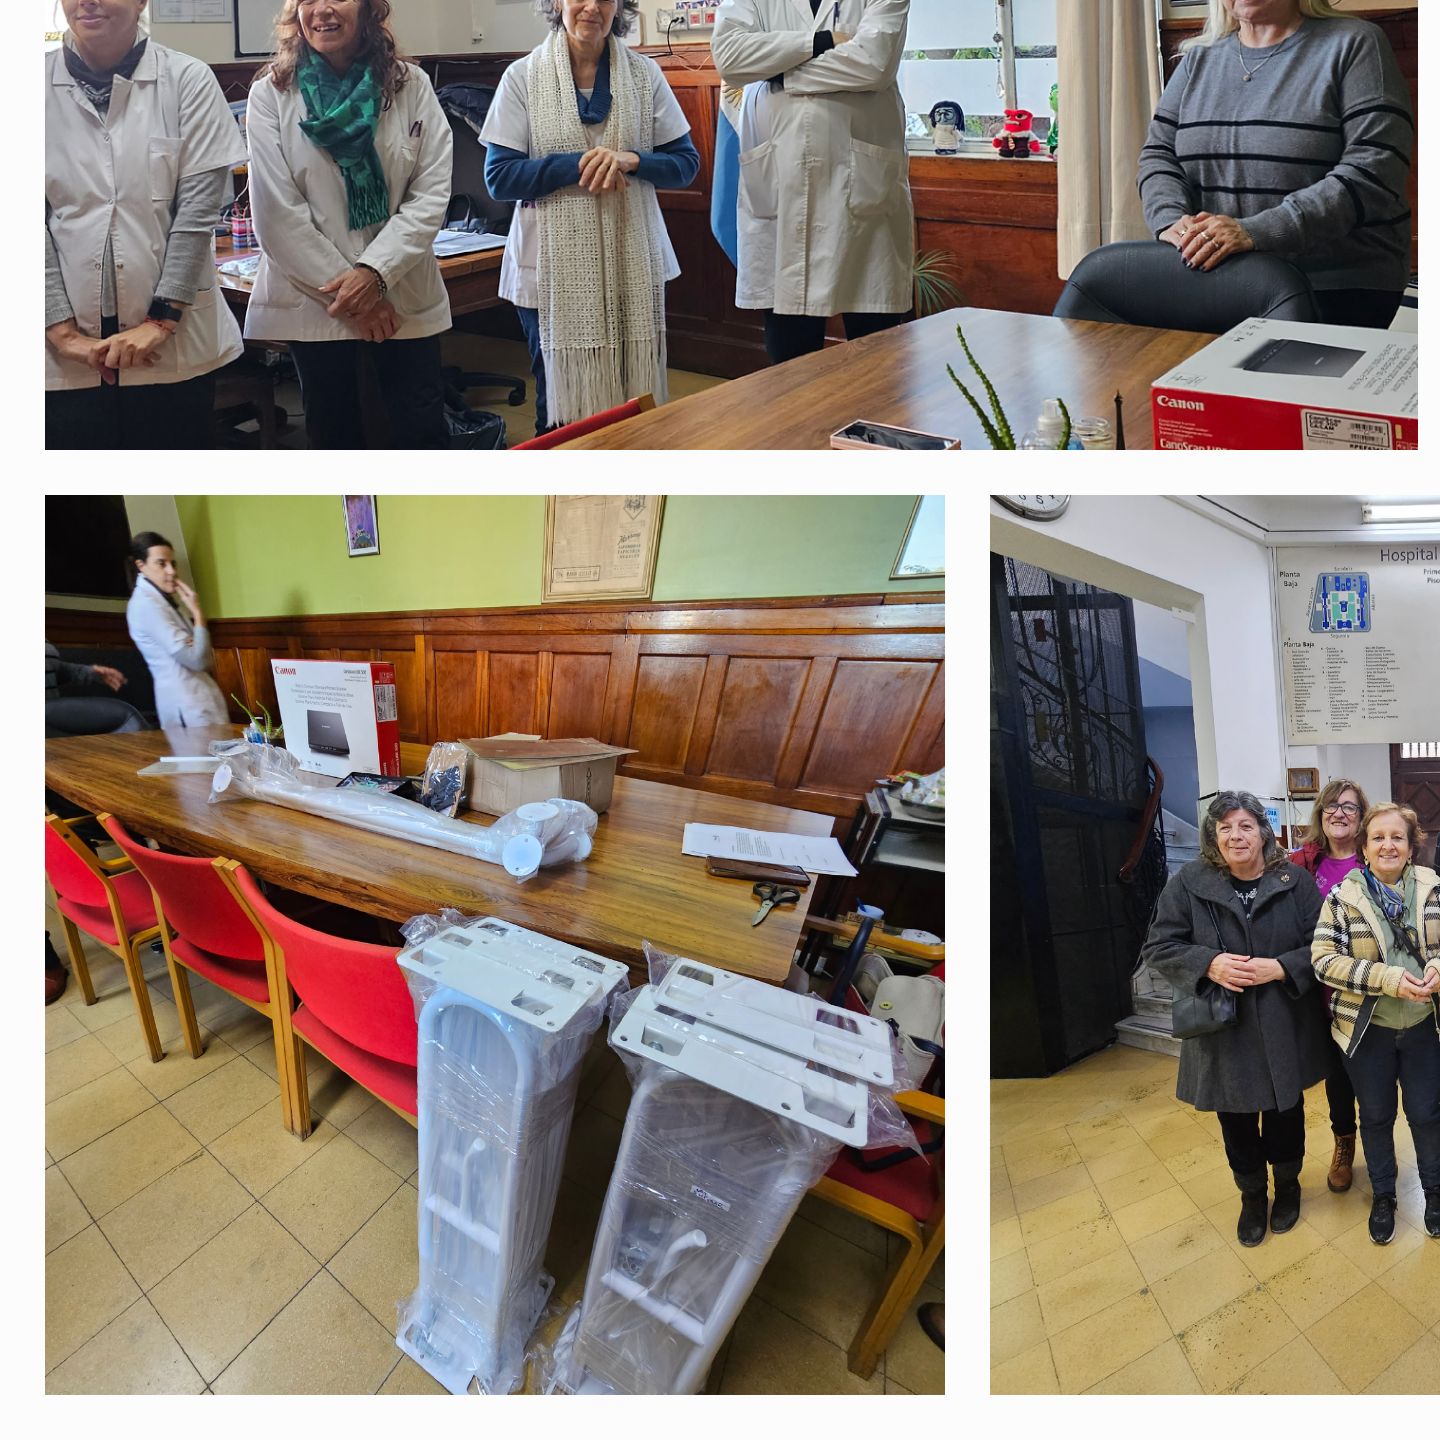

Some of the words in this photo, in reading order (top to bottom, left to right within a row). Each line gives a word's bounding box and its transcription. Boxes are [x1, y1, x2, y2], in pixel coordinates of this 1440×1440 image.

[1157, 395, 1205, 411] Canon
[1380, 546, 1438, 564] Hospital
[274, 665, 296, 676] Canon
